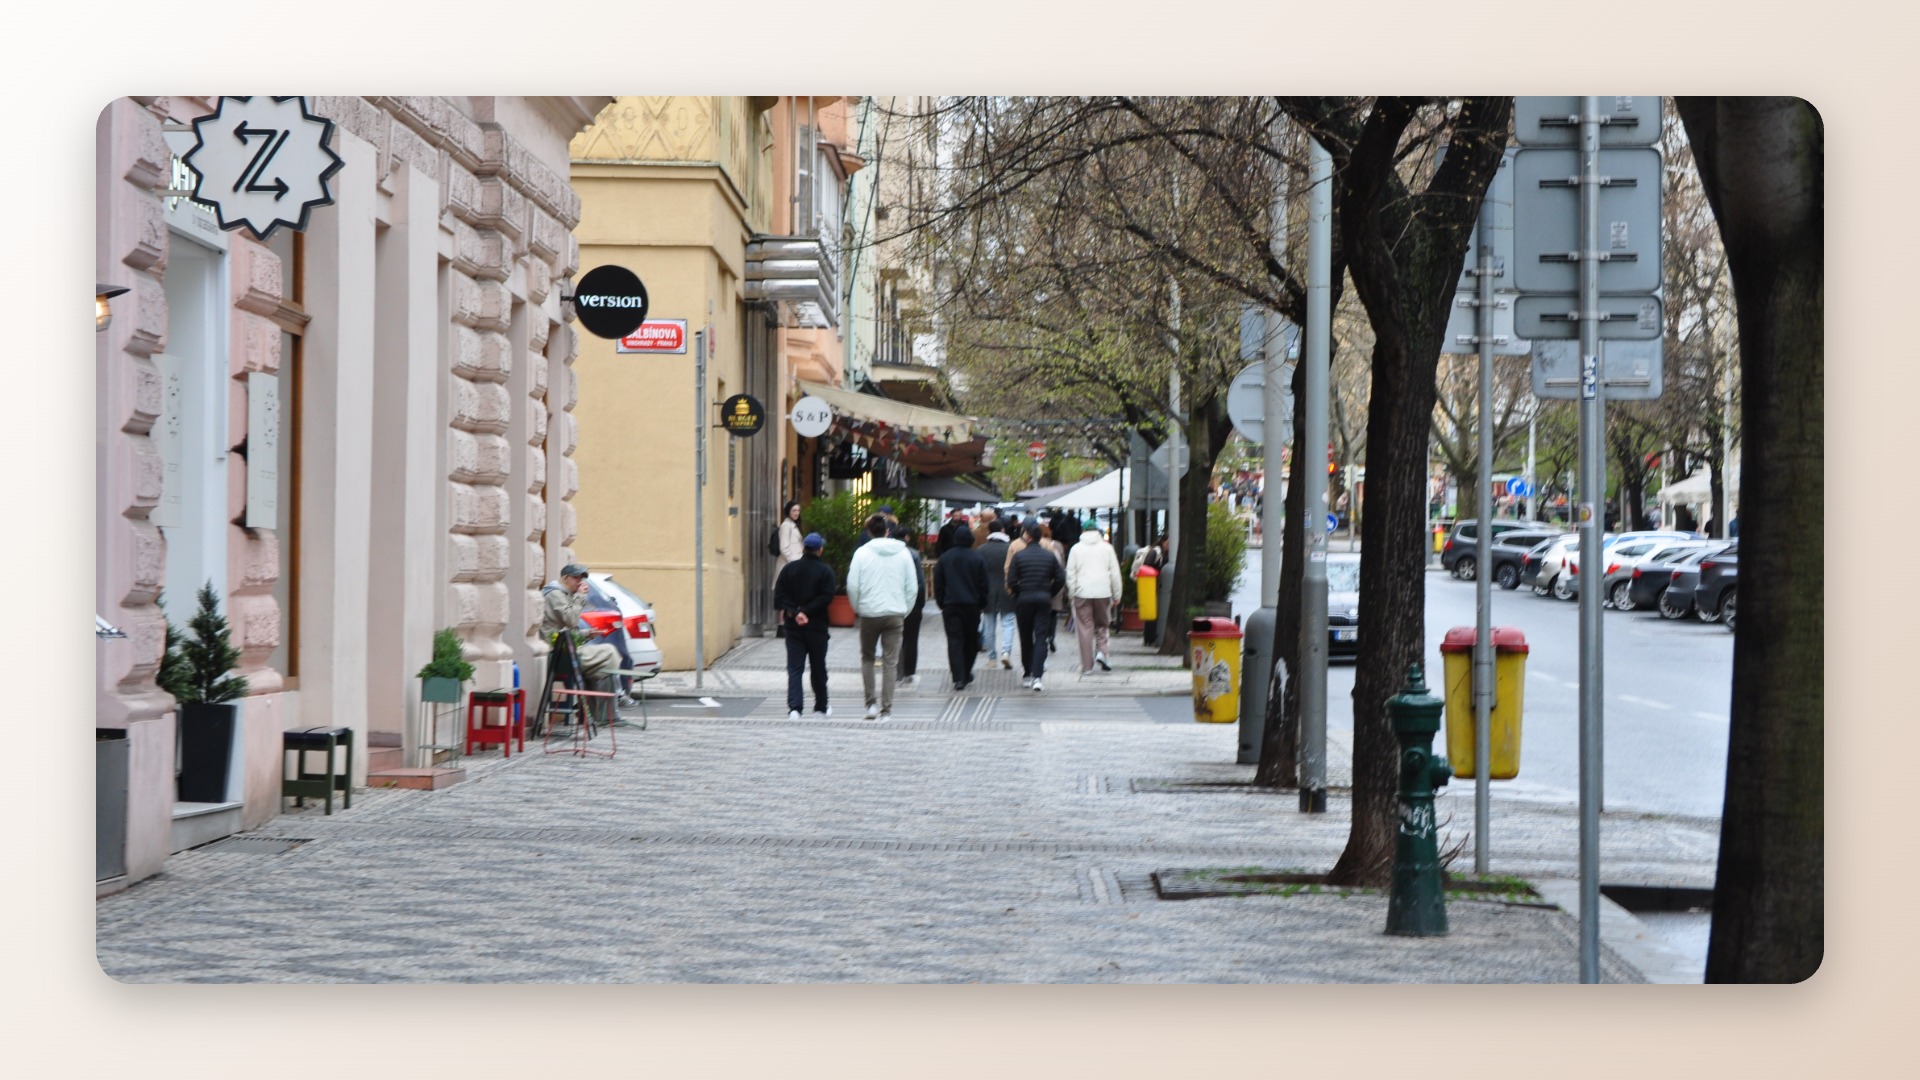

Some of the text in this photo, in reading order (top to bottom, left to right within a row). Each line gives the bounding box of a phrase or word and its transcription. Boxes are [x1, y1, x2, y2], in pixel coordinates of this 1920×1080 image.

[579, 294, 642, 308] version
[626, 326, 677, 339] ALBÍNOVA
[795, 411, 803, 422] S
[820, 411, 828, 422] P
